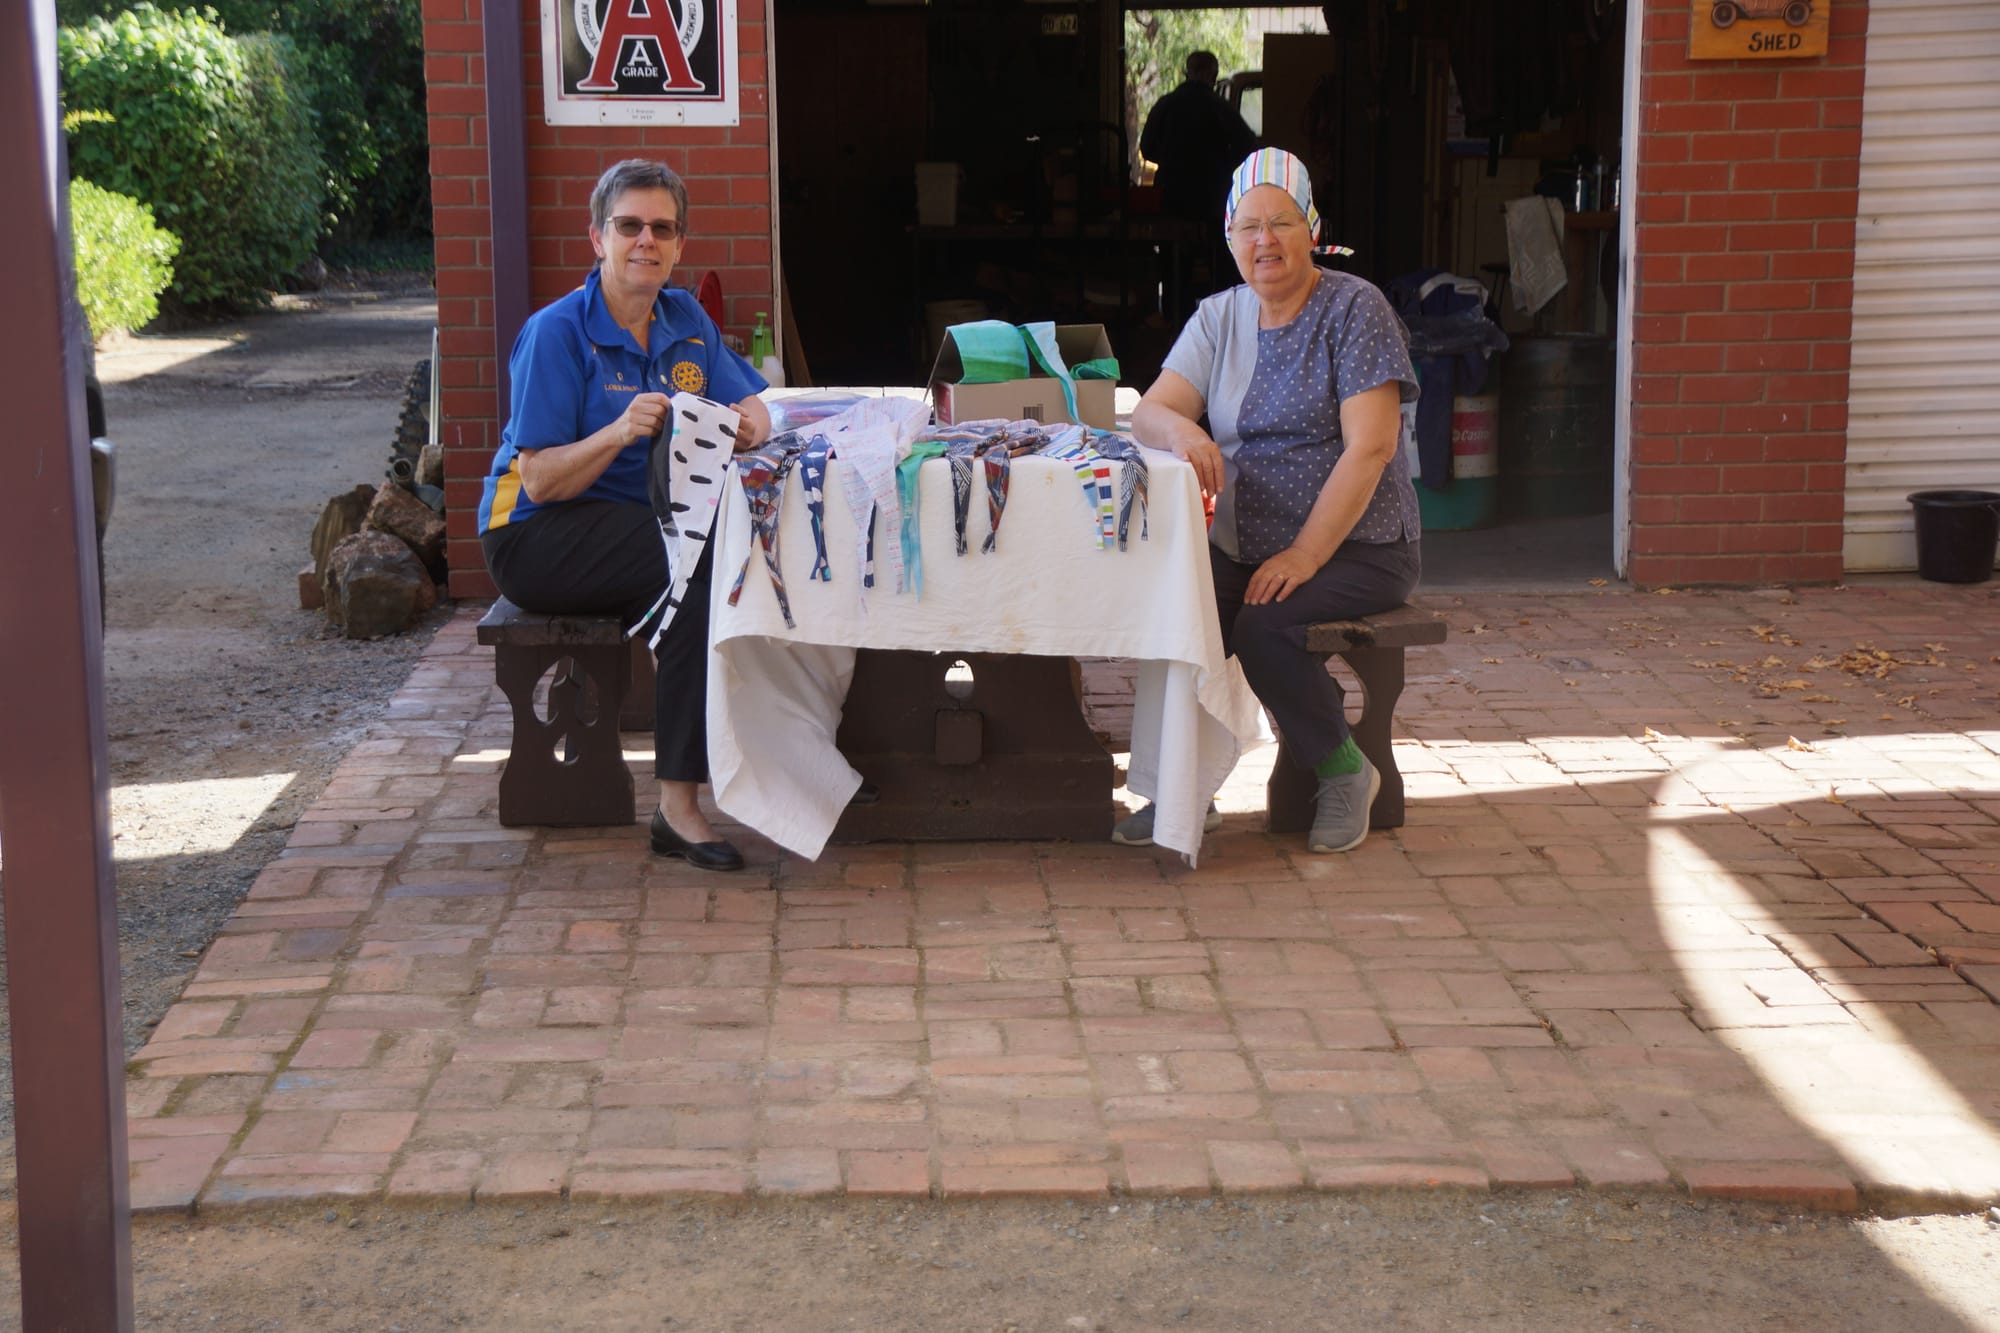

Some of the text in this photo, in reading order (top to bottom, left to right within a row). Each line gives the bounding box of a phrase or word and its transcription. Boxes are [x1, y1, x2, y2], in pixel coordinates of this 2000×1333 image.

[576, 0, 705, 91] A
[1748, 32, 1802, 52] SHED
[627, 41, 652, 66] A
[622, 66, 658, 77] GRADE
